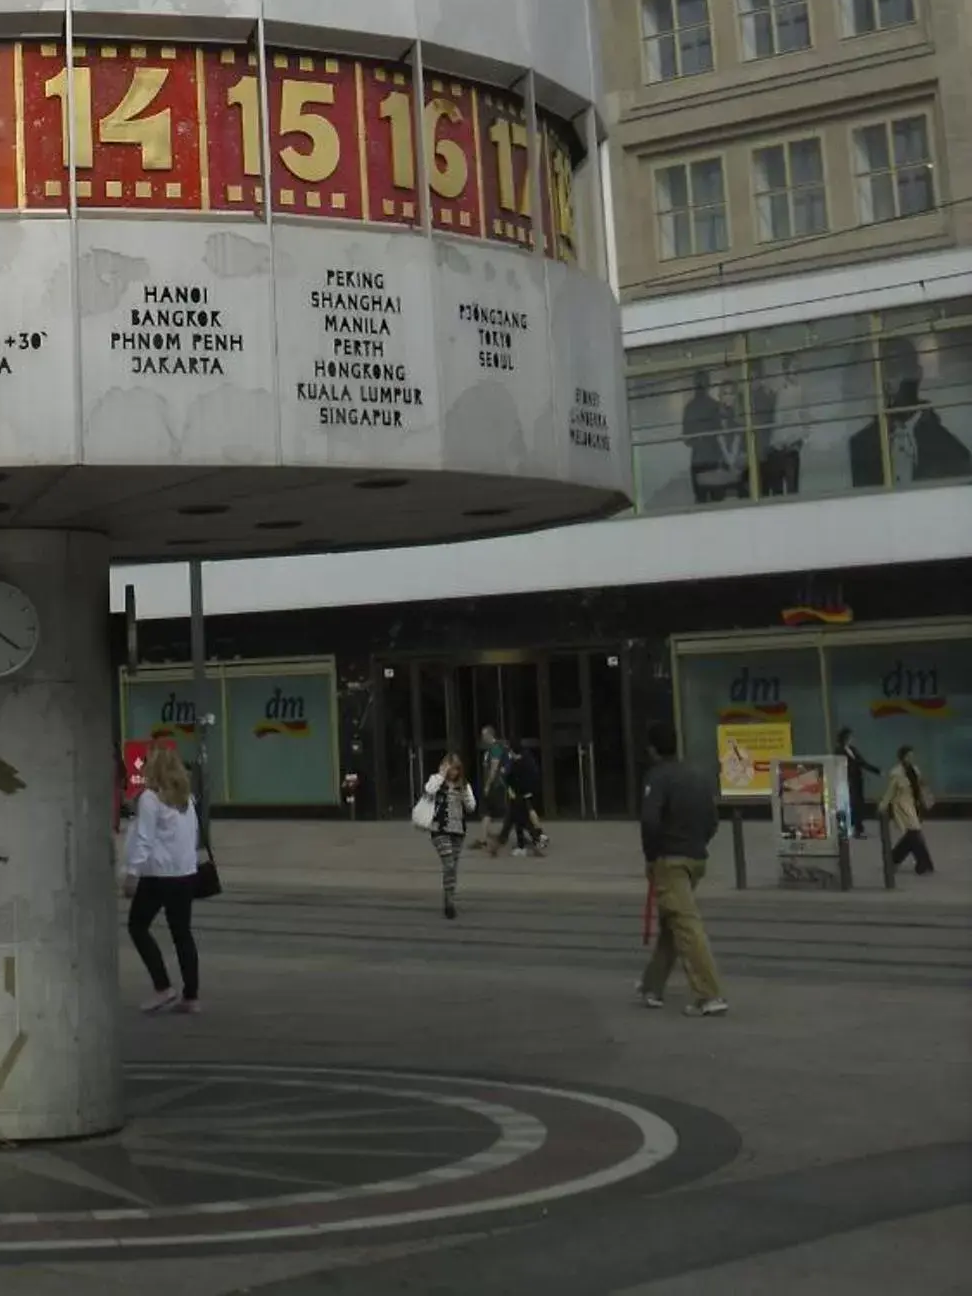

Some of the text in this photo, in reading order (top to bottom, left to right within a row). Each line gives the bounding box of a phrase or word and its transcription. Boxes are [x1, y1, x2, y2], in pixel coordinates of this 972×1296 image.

[45, 67, 173, 170] 14
[228, 75, 341, 182] 15
[380, 91, 468, 198] 16
[326, 269, 384, 290] PEKING
[144, 286, 208, 304] HANOI
[311, 291, 401, 314] SHANGHAI
[131, 309, 223, 328] BANGKOK
[325, 314, 391, 336] MANILA
[111, 332, 244, 352] PHNOM PENH
[334, 338, 384, 357] PERTH
[479, 329, 512, 349] TOKYO
[131, 356, 224, 375] JAKARTA
[315, 360, 405, 381] HONGKONG
[479, 350, 514, 370] SEOUL
[297, 383, 424, 405] KUALA LUMPUR
[320, 408, 403, 427] SINGAPUR
[730, 665, 782, 702] dm
[883, 659, 938, 698] dm
[162, 691, 196, 722] dm
[266, 687, 305, 719] dm
